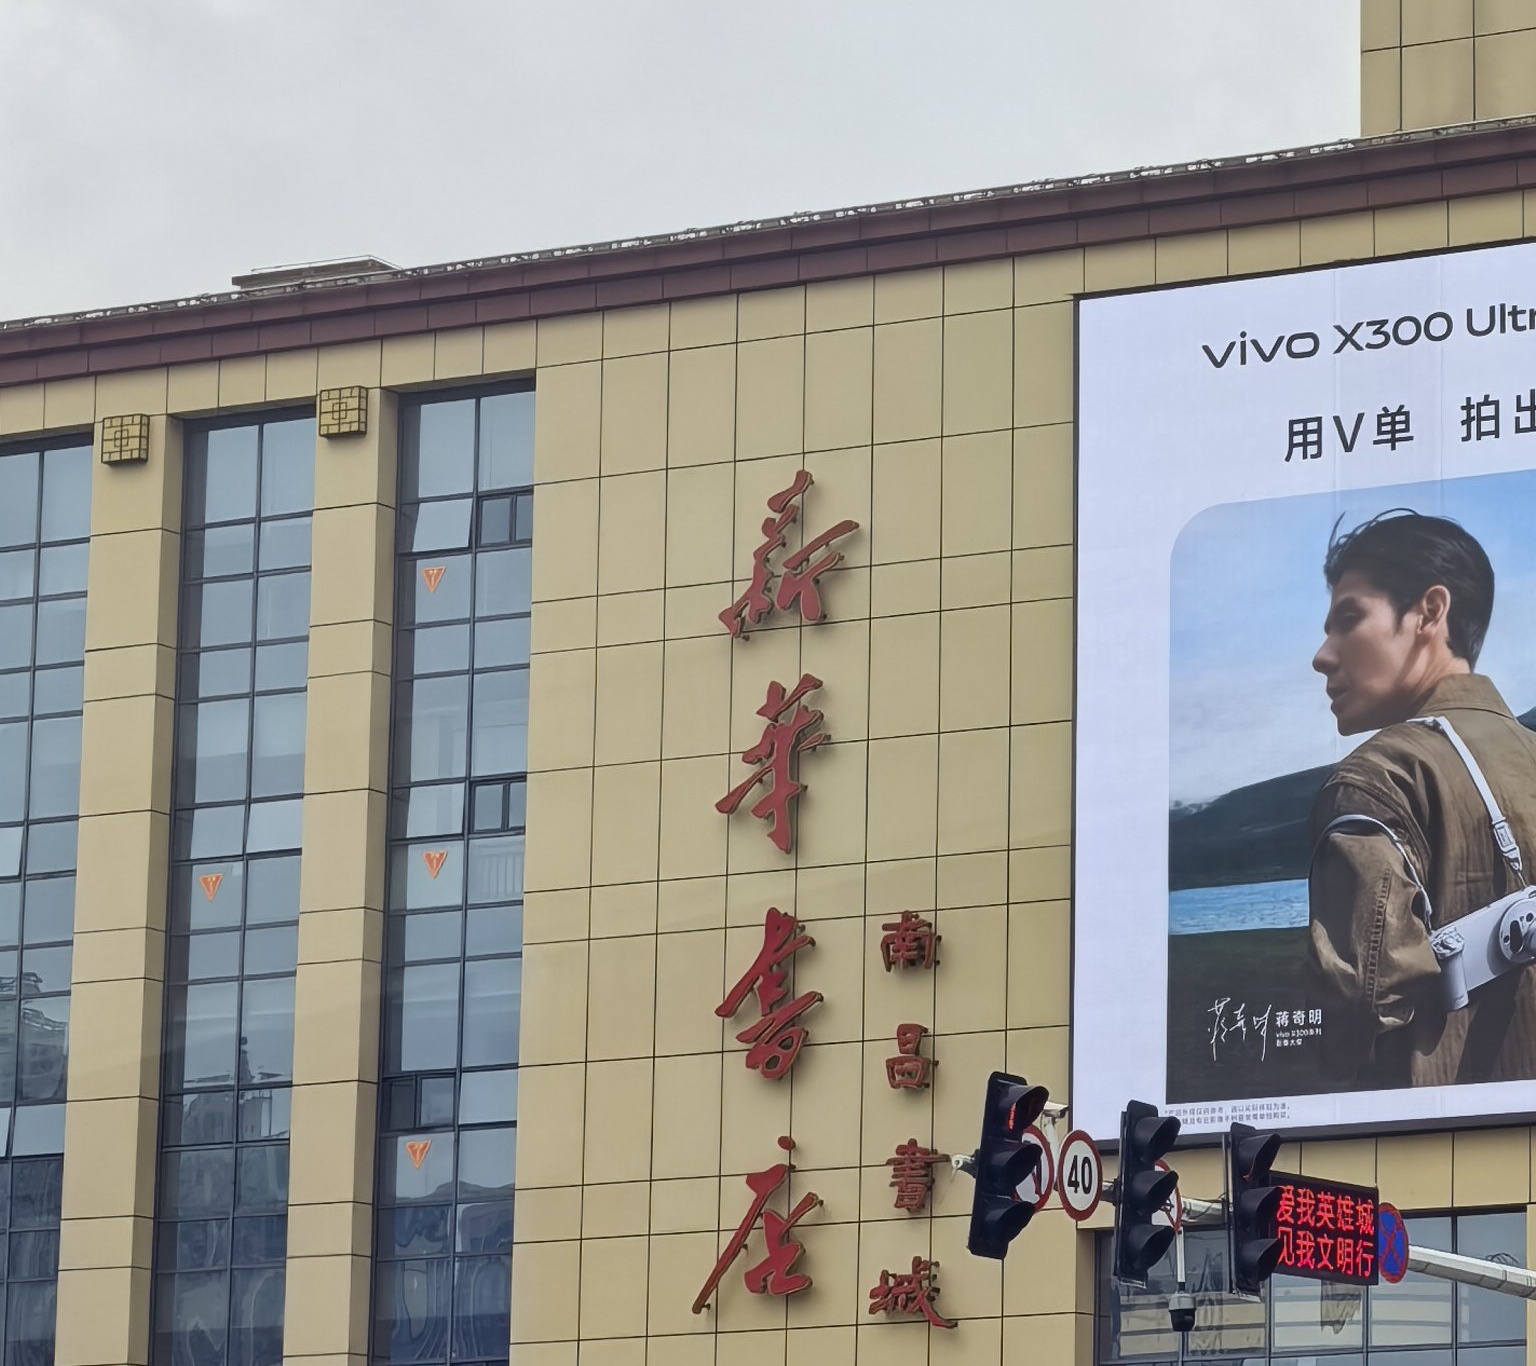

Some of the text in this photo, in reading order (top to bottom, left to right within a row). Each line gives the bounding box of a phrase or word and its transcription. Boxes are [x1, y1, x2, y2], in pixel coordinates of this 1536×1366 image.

[1202, 329, 1320, 369] vivo
[1333, 312, 1453, 356] X300
[1285, 405, 1414, 463] 用V单
[1275, 1008, 1322, 1027] 蒋奇明
[1067, 1154, 1093, 1195] 40
[1276, 1184, 1375, 1236] 爱我英雄城
[1277, 1226, 1375, 1278] 见我文明行
